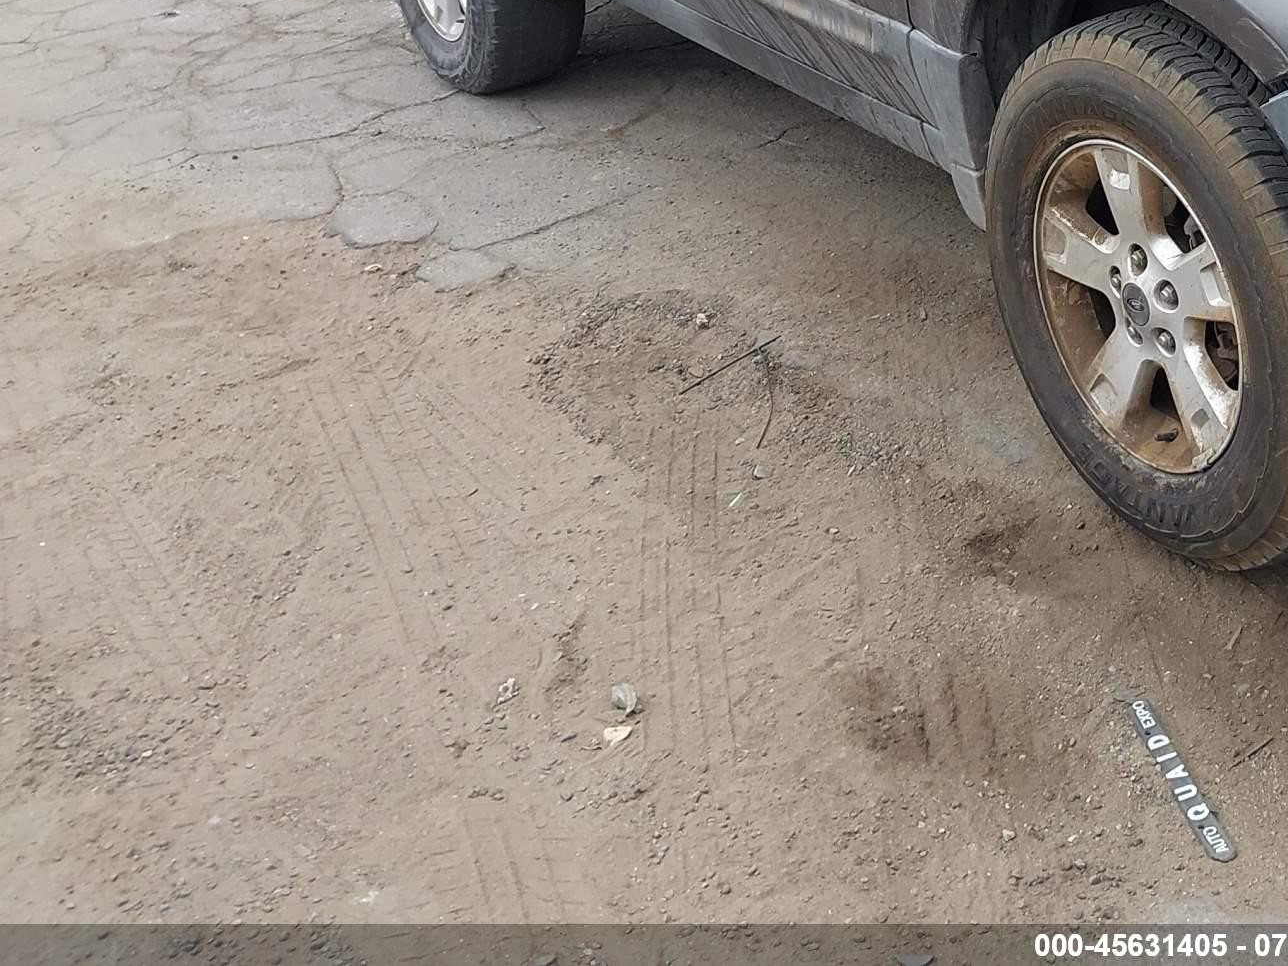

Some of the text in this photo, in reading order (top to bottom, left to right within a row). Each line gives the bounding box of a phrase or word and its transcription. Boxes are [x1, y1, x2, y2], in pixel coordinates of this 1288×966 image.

[1132, 700, 1230, 853] AUTO QUAID EXPO
